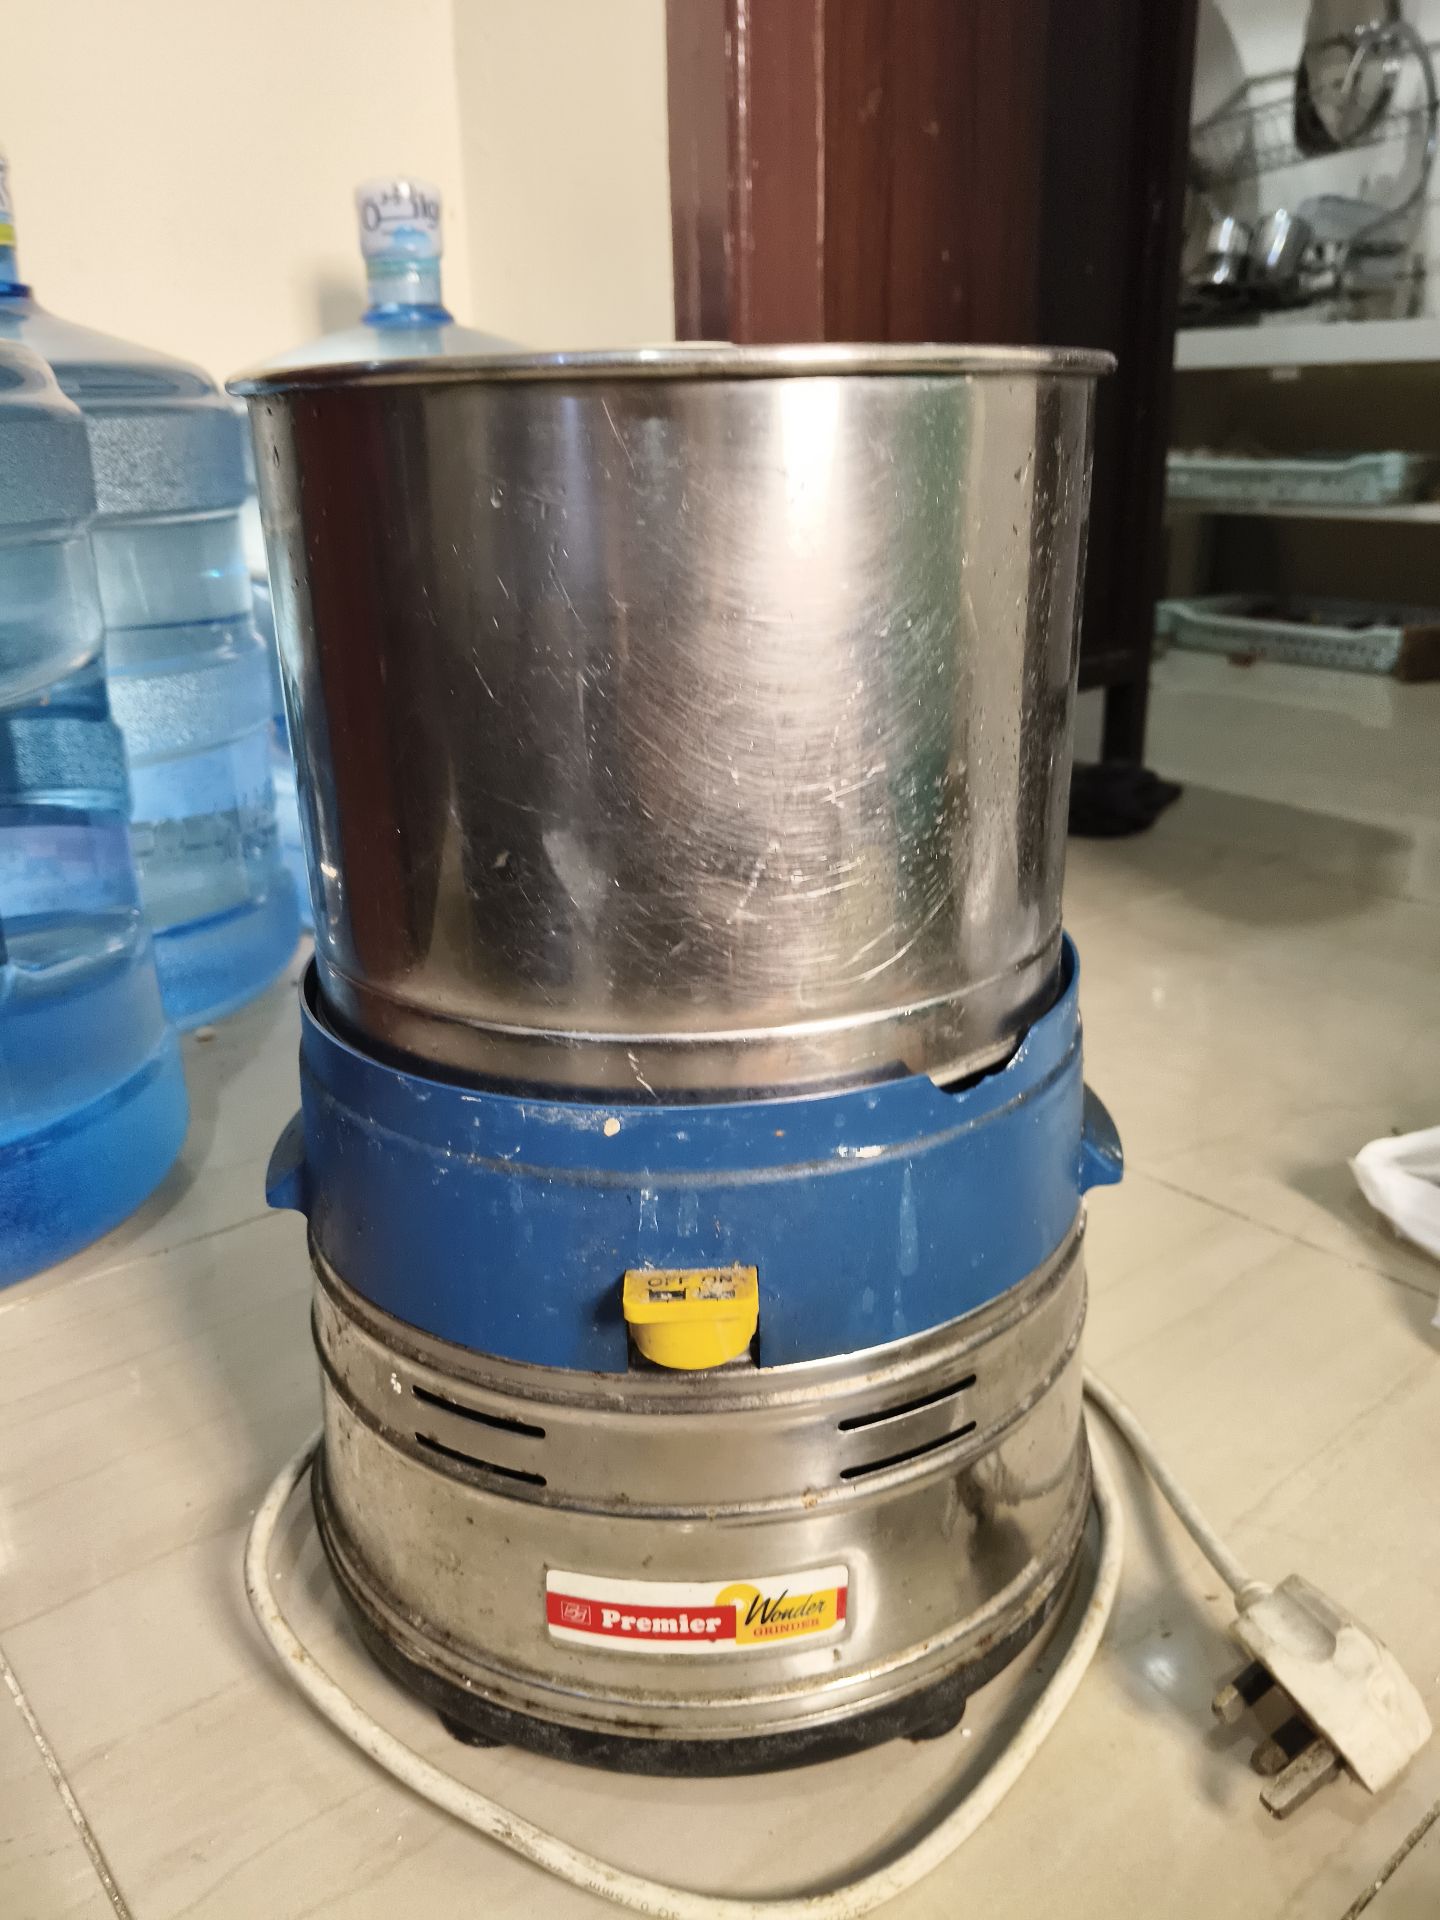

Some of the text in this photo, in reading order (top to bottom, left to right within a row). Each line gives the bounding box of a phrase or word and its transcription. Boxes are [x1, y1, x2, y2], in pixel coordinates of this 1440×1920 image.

[601, 1608, 722, 1634] Premier
[745, 1589, 826, 1626] Wonder
[753, 1617, 820, 1638] GRINDER
